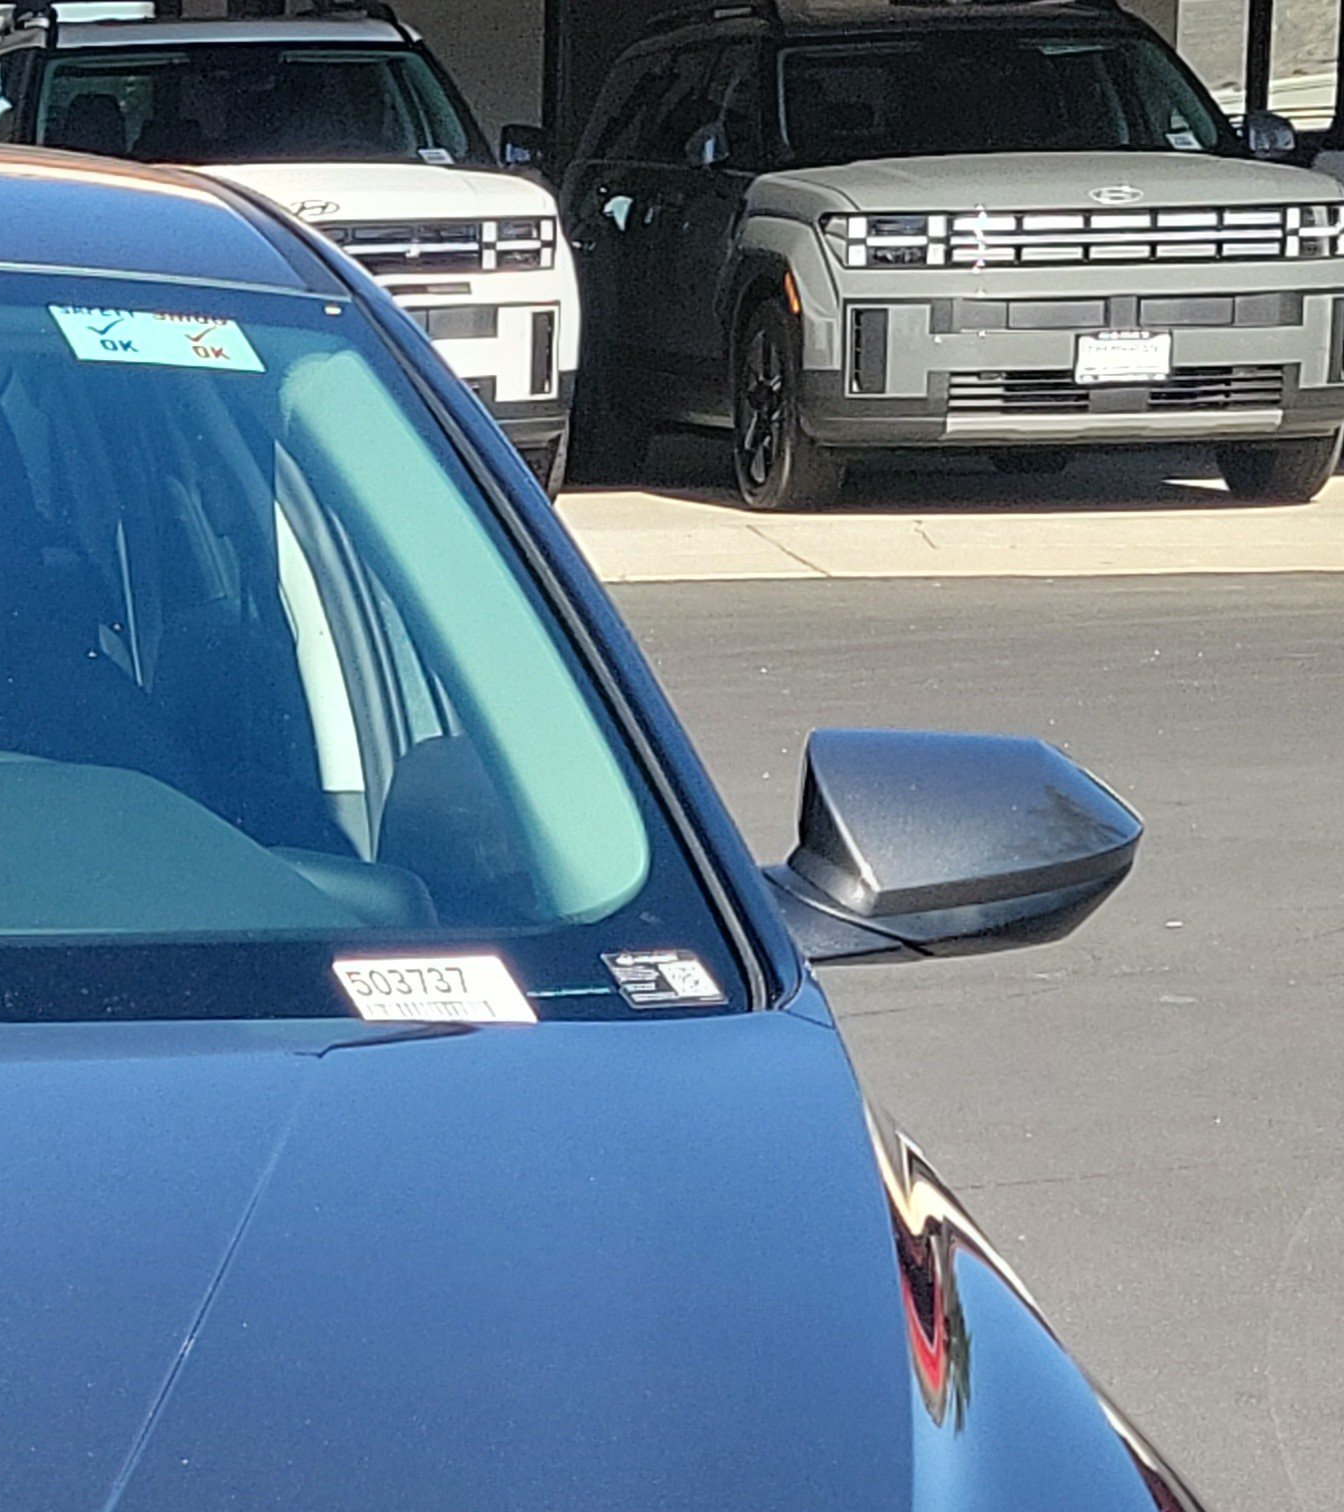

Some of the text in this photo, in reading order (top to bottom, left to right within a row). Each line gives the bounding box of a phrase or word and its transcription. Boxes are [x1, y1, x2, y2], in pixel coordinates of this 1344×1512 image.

[100, 339, 140, 353] OK
[192, 345, 231, 360] OK
[345, 967, 469, 996] 503737
